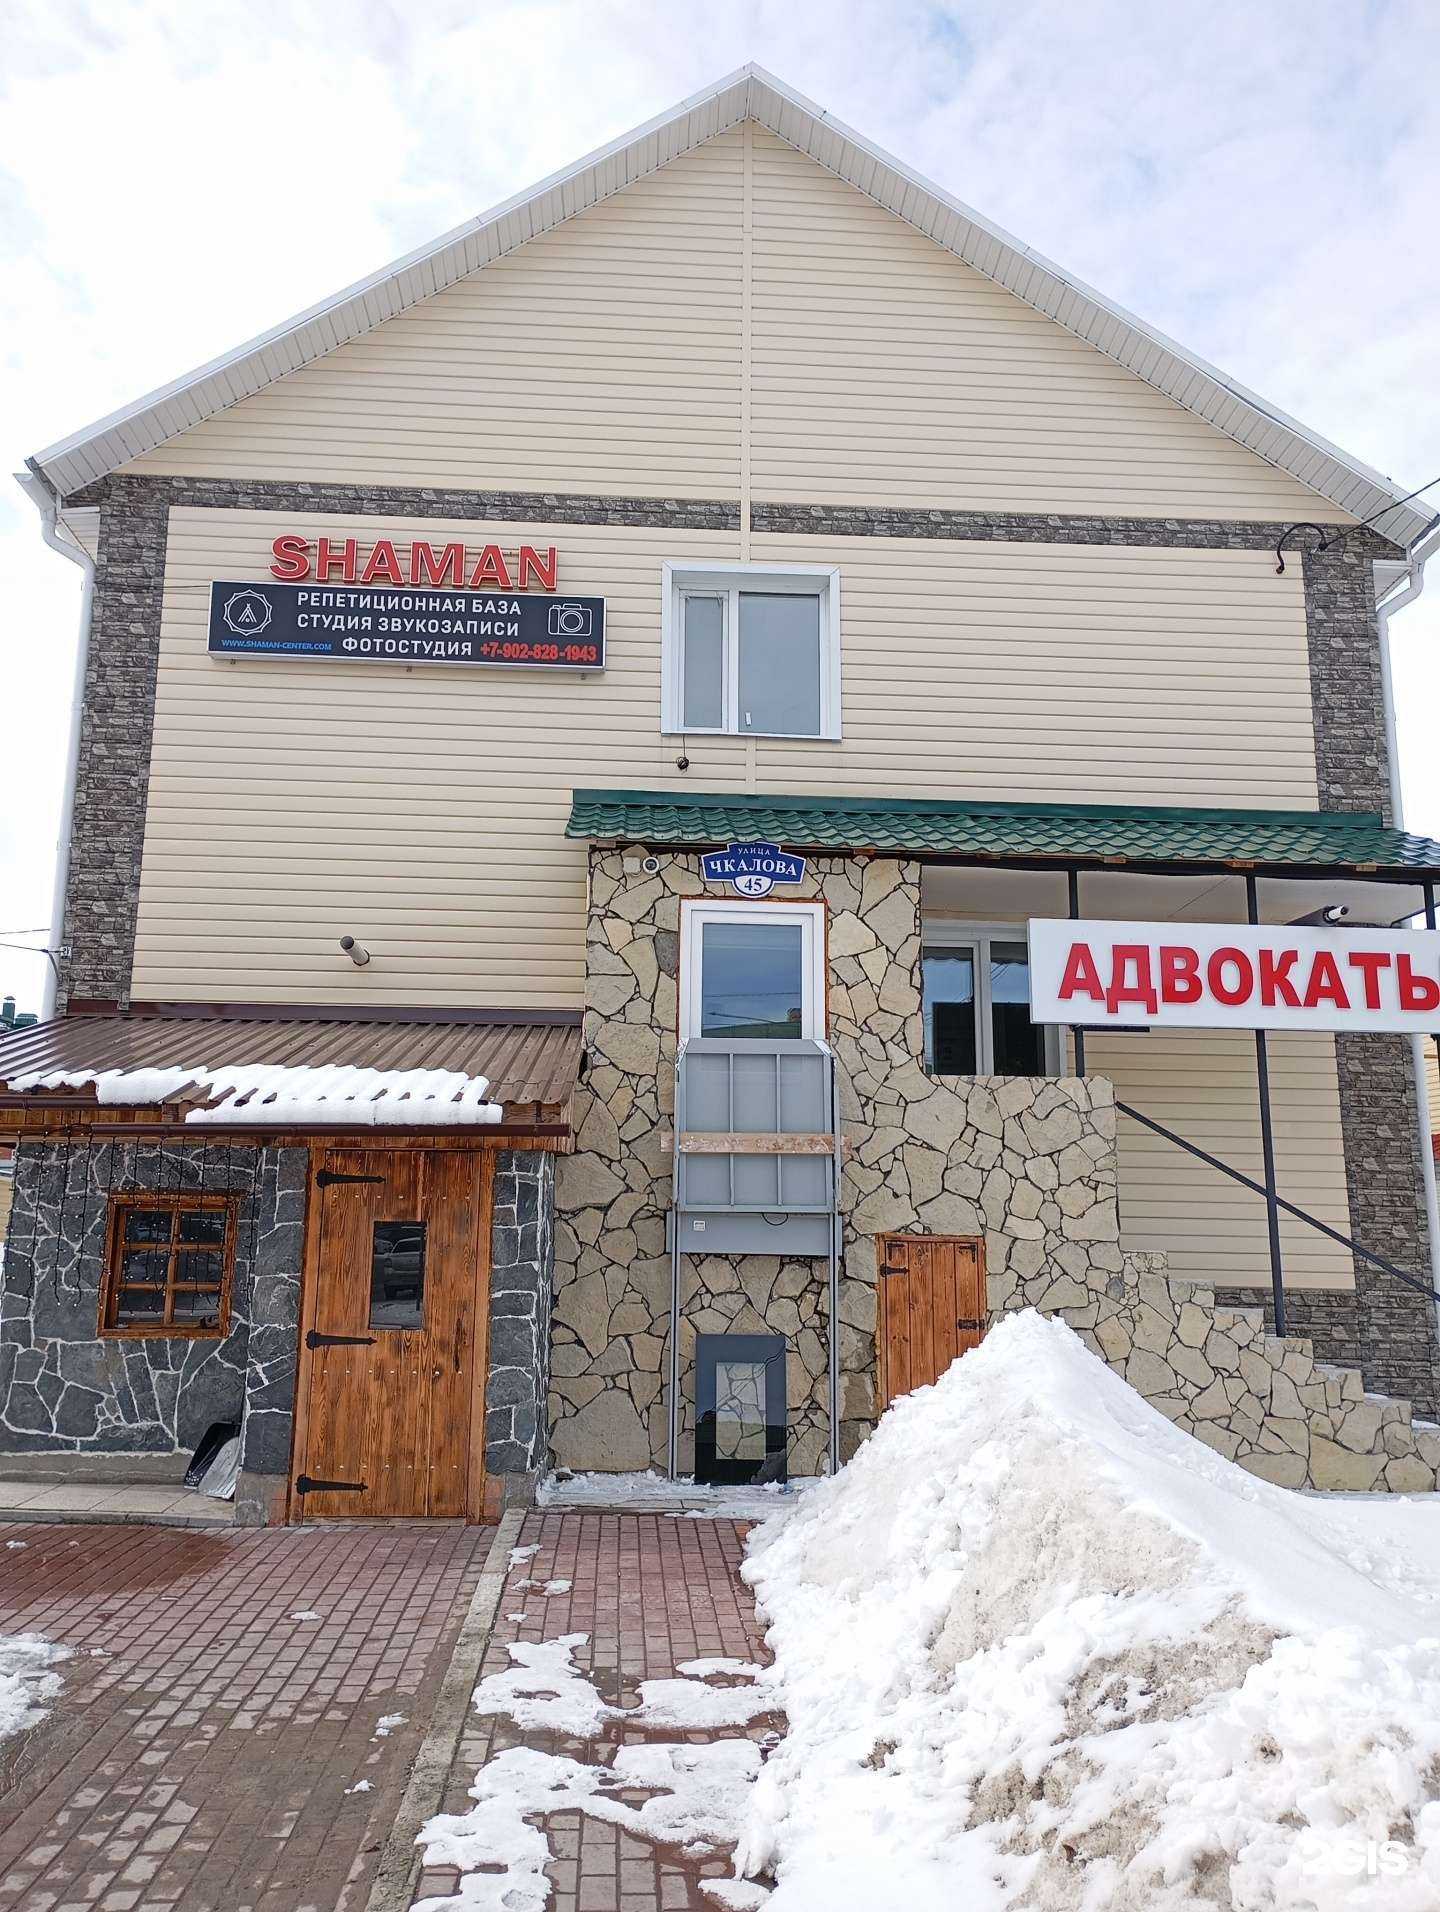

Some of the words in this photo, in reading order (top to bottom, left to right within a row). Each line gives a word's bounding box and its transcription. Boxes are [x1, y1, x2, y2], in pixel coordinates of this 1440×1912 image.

[269, 535, 558, 591] SHAMAN
[297, 591, 466, 615] РЕПЕТИЦИОННАЯ
[472, 599, 522, 616] БАЗА
[297, 614, 372, 633] СТУДИЯ
[378, 616, 520, 637] ЗВУКОЗАПИСИ
[342, 637, 473, 658] ФОТОСТУДИЯ
[480, 643, 597, 662] +7-902-828-1943
[737, 847, 771, 856] УЛИЦА
[709, 858, 797, 876] ЧКАЛОВА
[744, 877, 762, 892] 45
